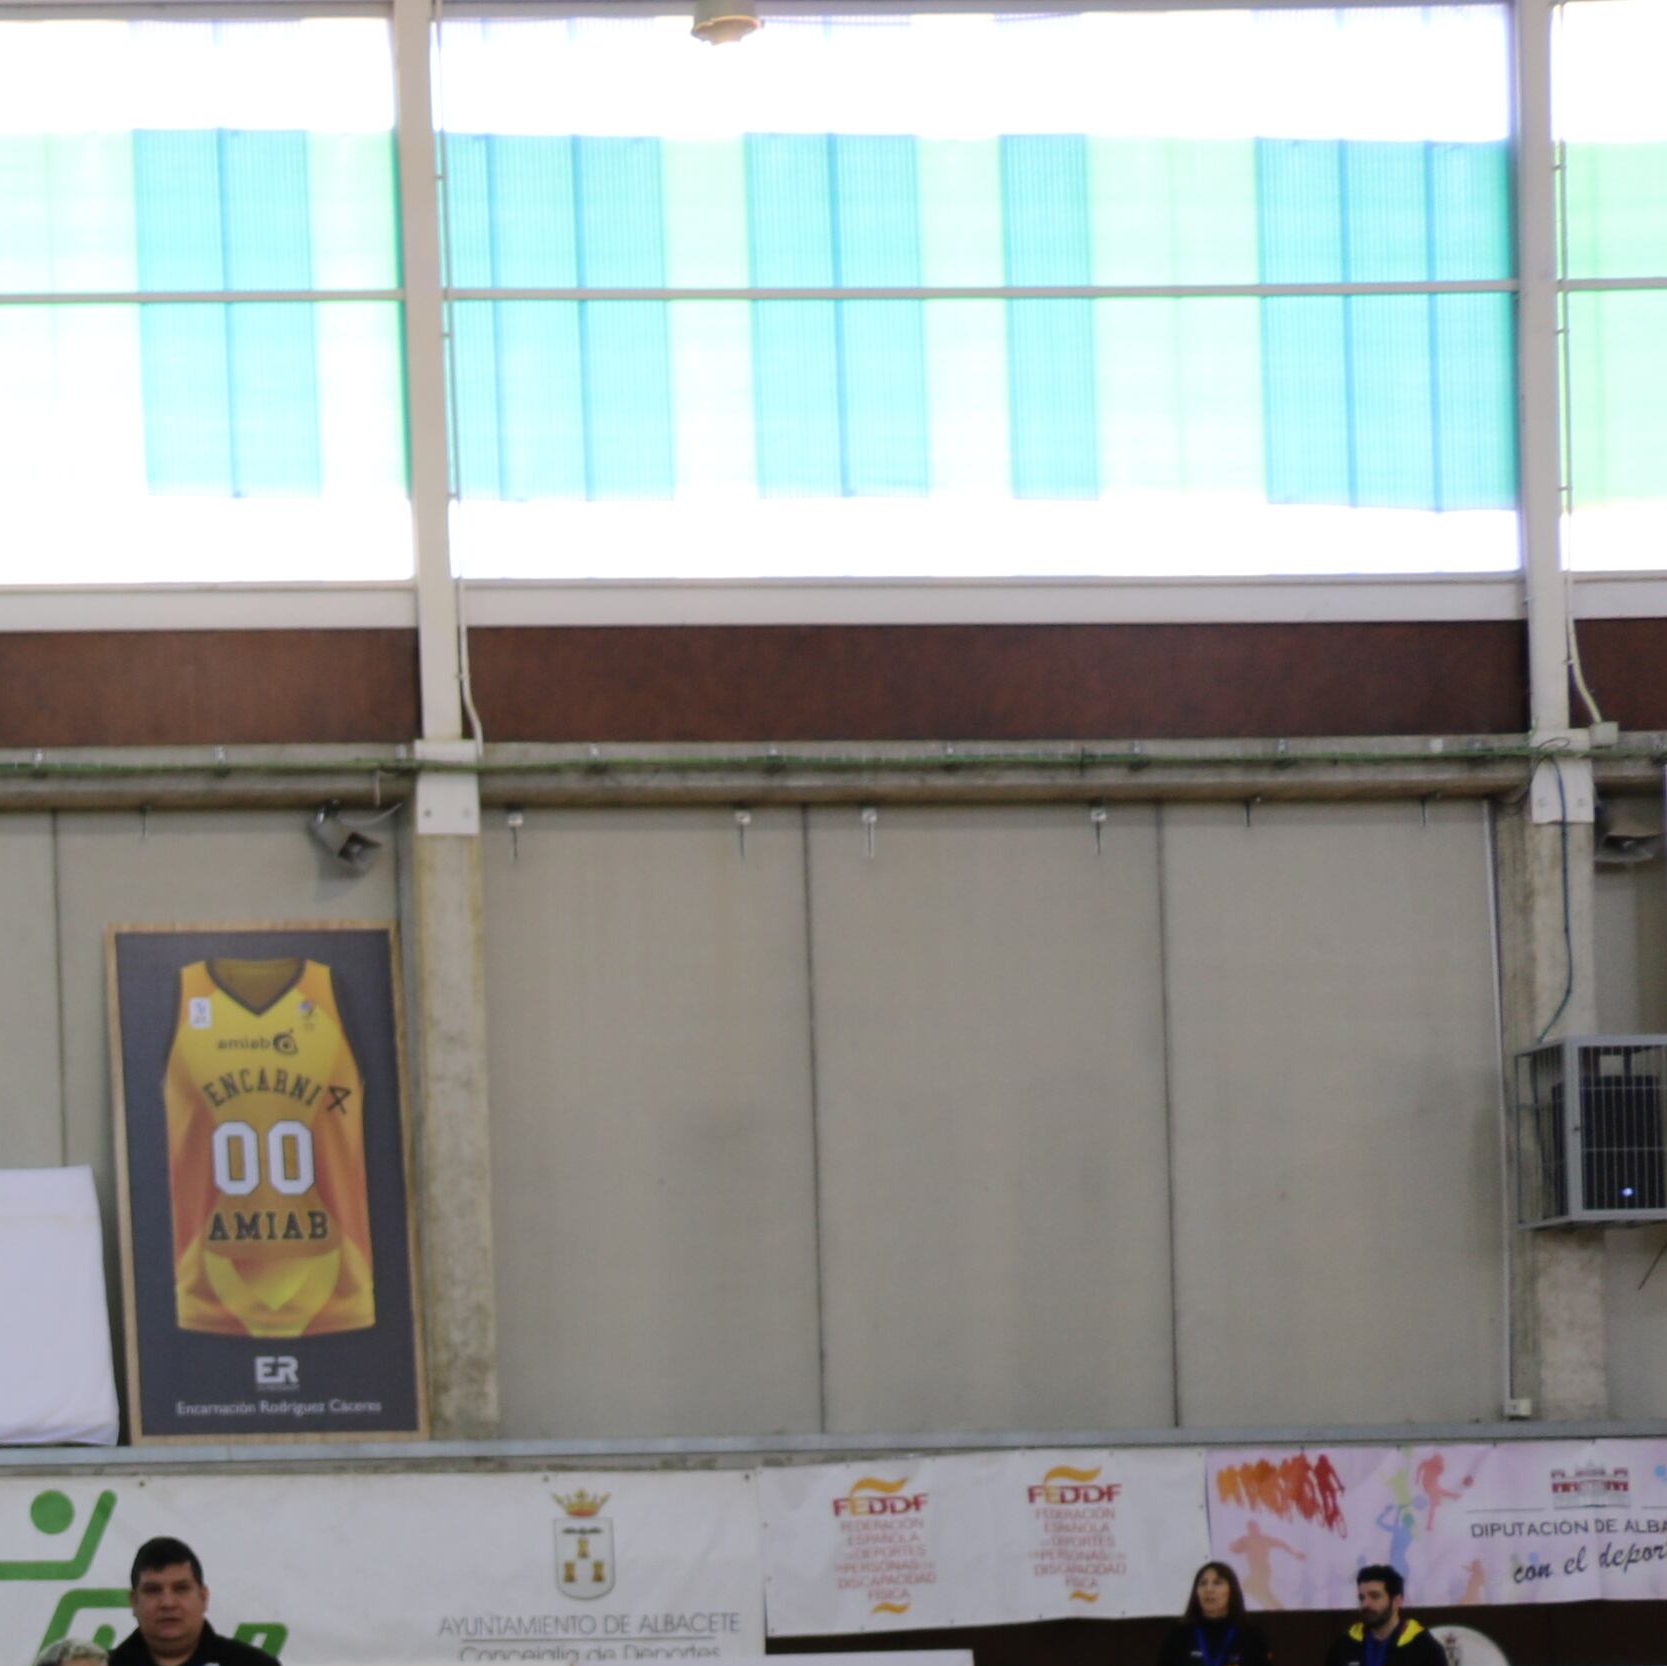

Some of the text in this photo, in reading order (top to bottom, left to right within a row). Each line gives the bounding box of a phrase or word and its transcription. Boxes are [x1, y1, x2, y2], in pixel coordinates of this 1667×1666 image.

[203, 1067, 323, 1108] ENCARNI
[212, 1119, 316, 1197] 00
[208, 1210, 328, 1242] AMIAB
[255, 1356, 300, 1384] ER
[1595, 1519, 1617, 1534] DE
[1512, 1561, 1552, 1584] con
[1563, 1545, 1587, 1575] el
[437, 1610, 741, 1637] AYUNTAMIENTO DE ALBACETE
